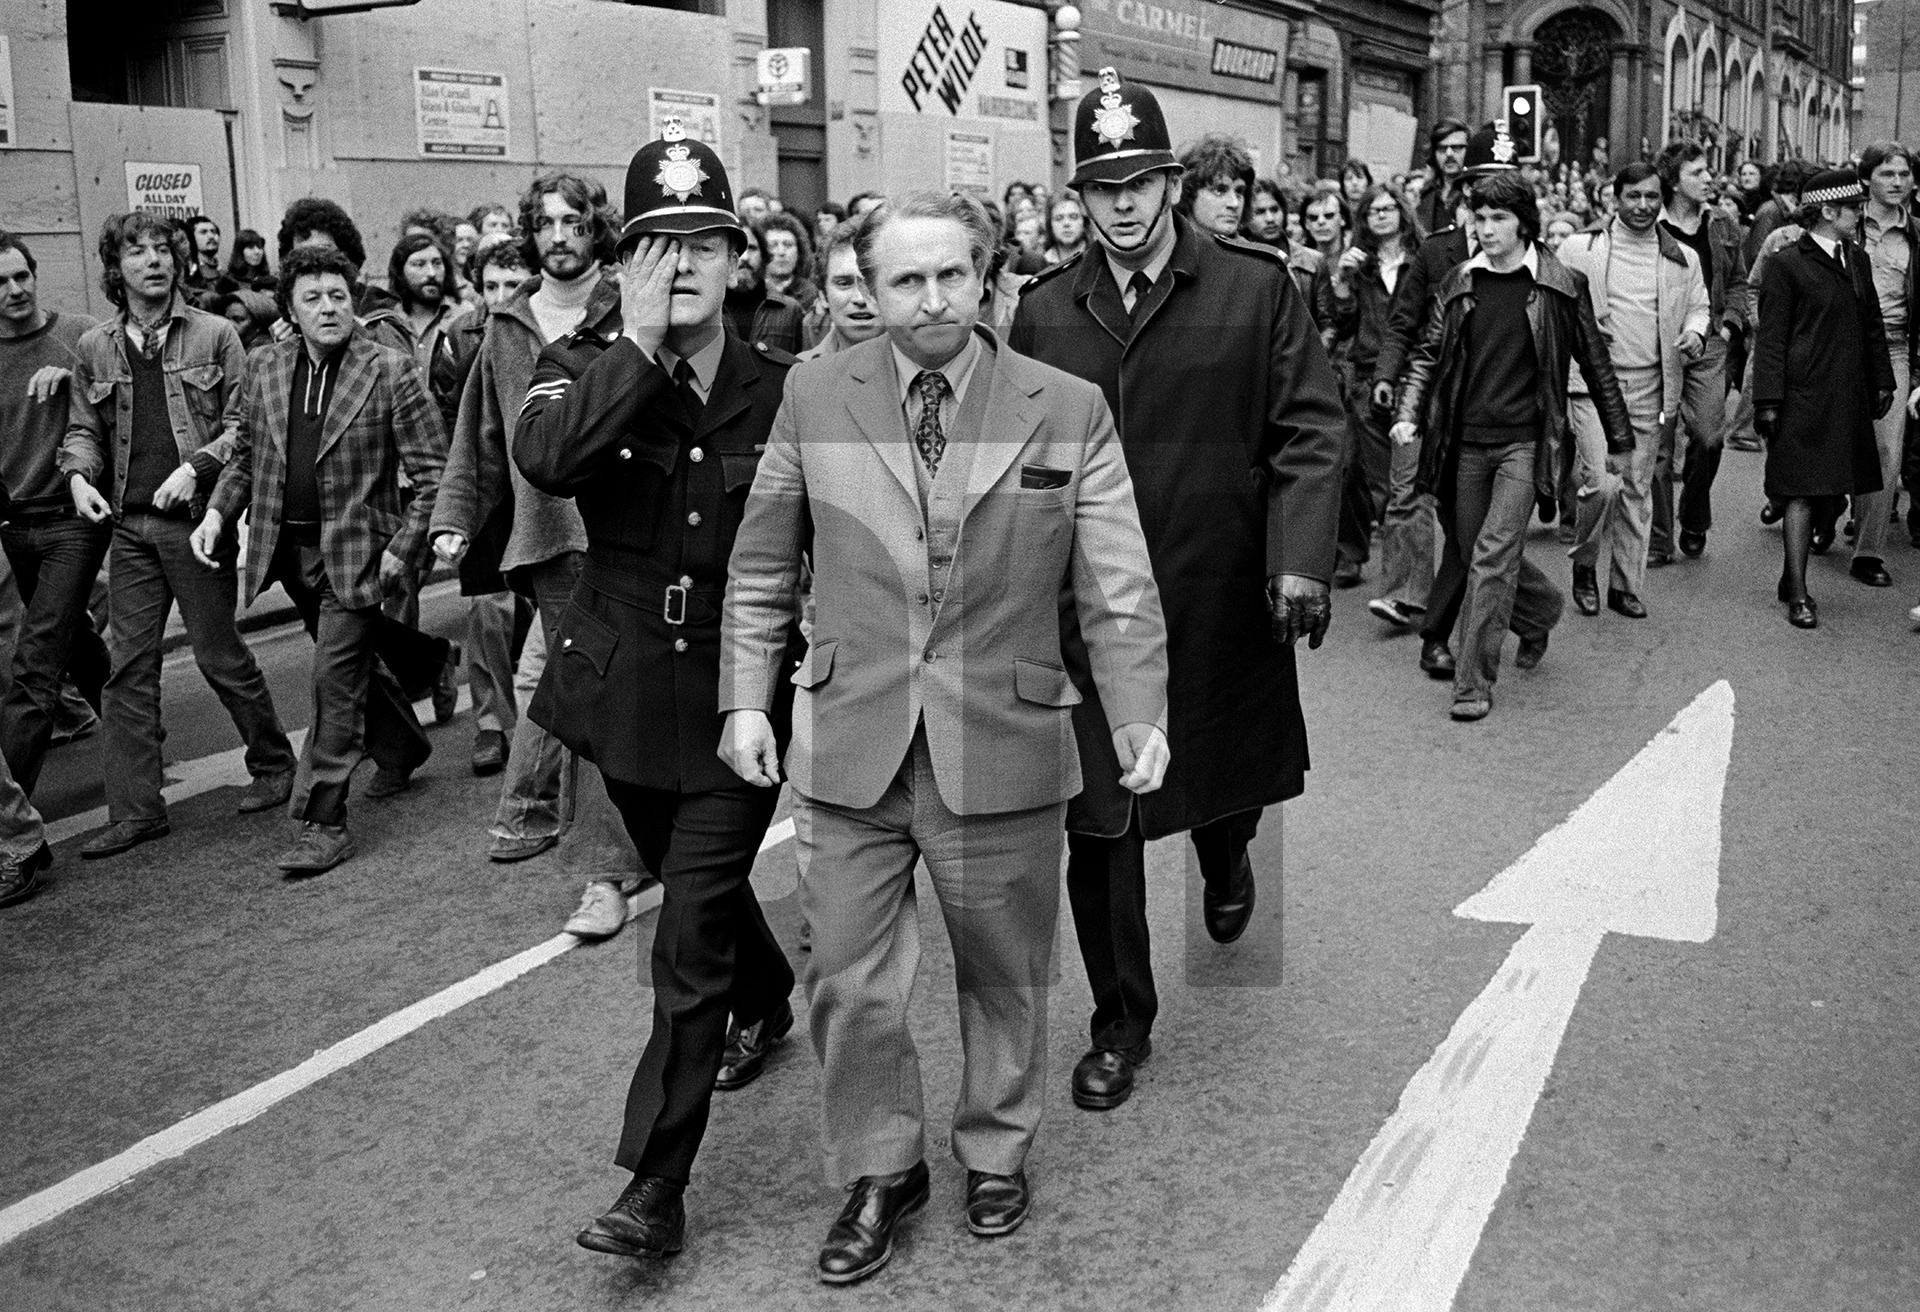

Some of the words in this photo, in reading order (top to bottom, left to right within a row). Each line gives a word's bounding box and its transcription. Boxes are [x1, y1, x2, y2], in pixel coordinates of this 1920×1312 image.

[1117, 0, 1213, 42] CARMEL
[902, 6, 954, 112] PETER
[937, 11, 987, 115] WILDE
[135, 173, 192, 191] CLOSED
[144, 195, 164, 203] ALL
[165, 194, 186, 203] DAY
